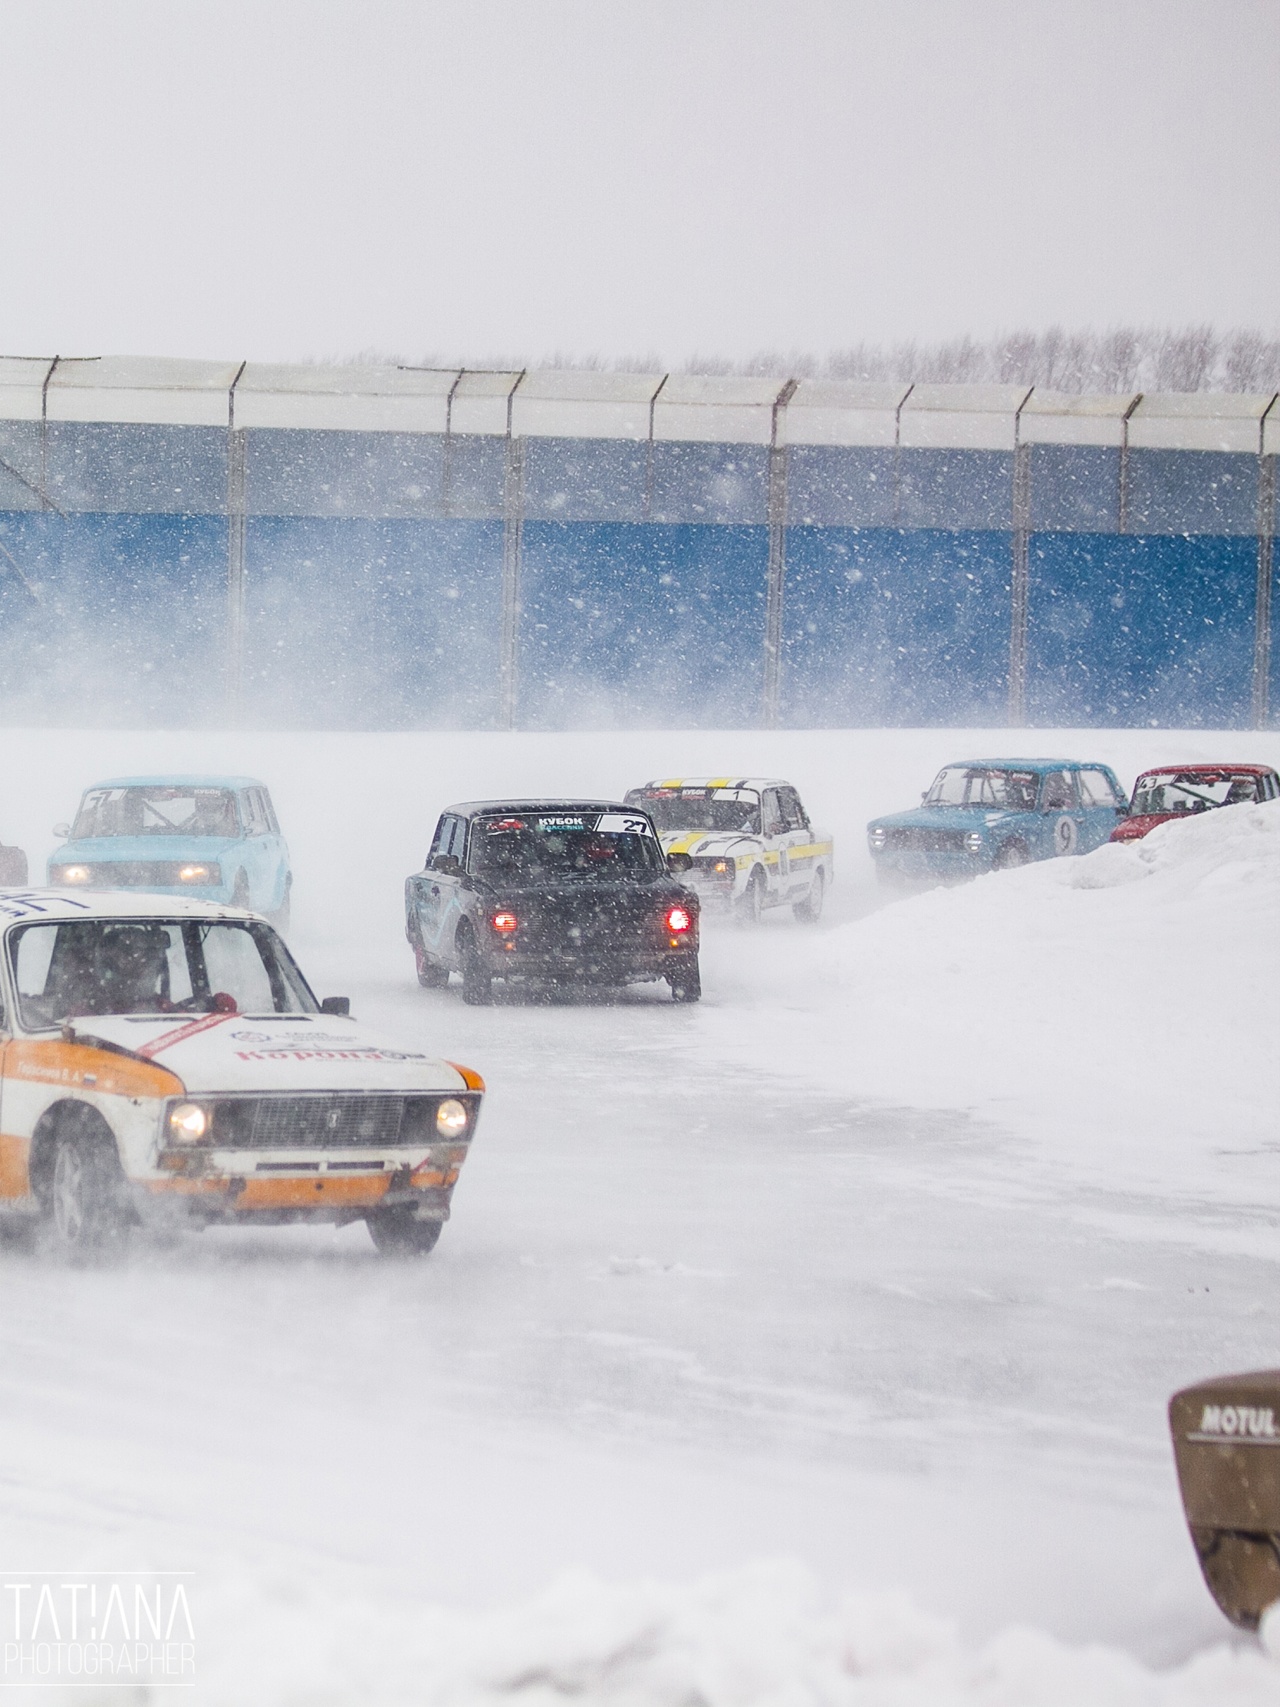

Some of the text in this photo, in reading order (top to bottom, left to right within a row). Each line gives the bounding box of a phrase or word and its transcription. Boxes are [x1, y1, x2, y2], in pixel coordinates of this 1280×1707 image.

[1139, 777, 1157, 789] 43
[733, 791, 740, 801] 1
[538, 817, 583, 825] КУБОК
[622, 818, 648, 834] 27
[1058, 820, 1073, 851] 9
[1201, 1404, 1276, 1437] MOTUL
